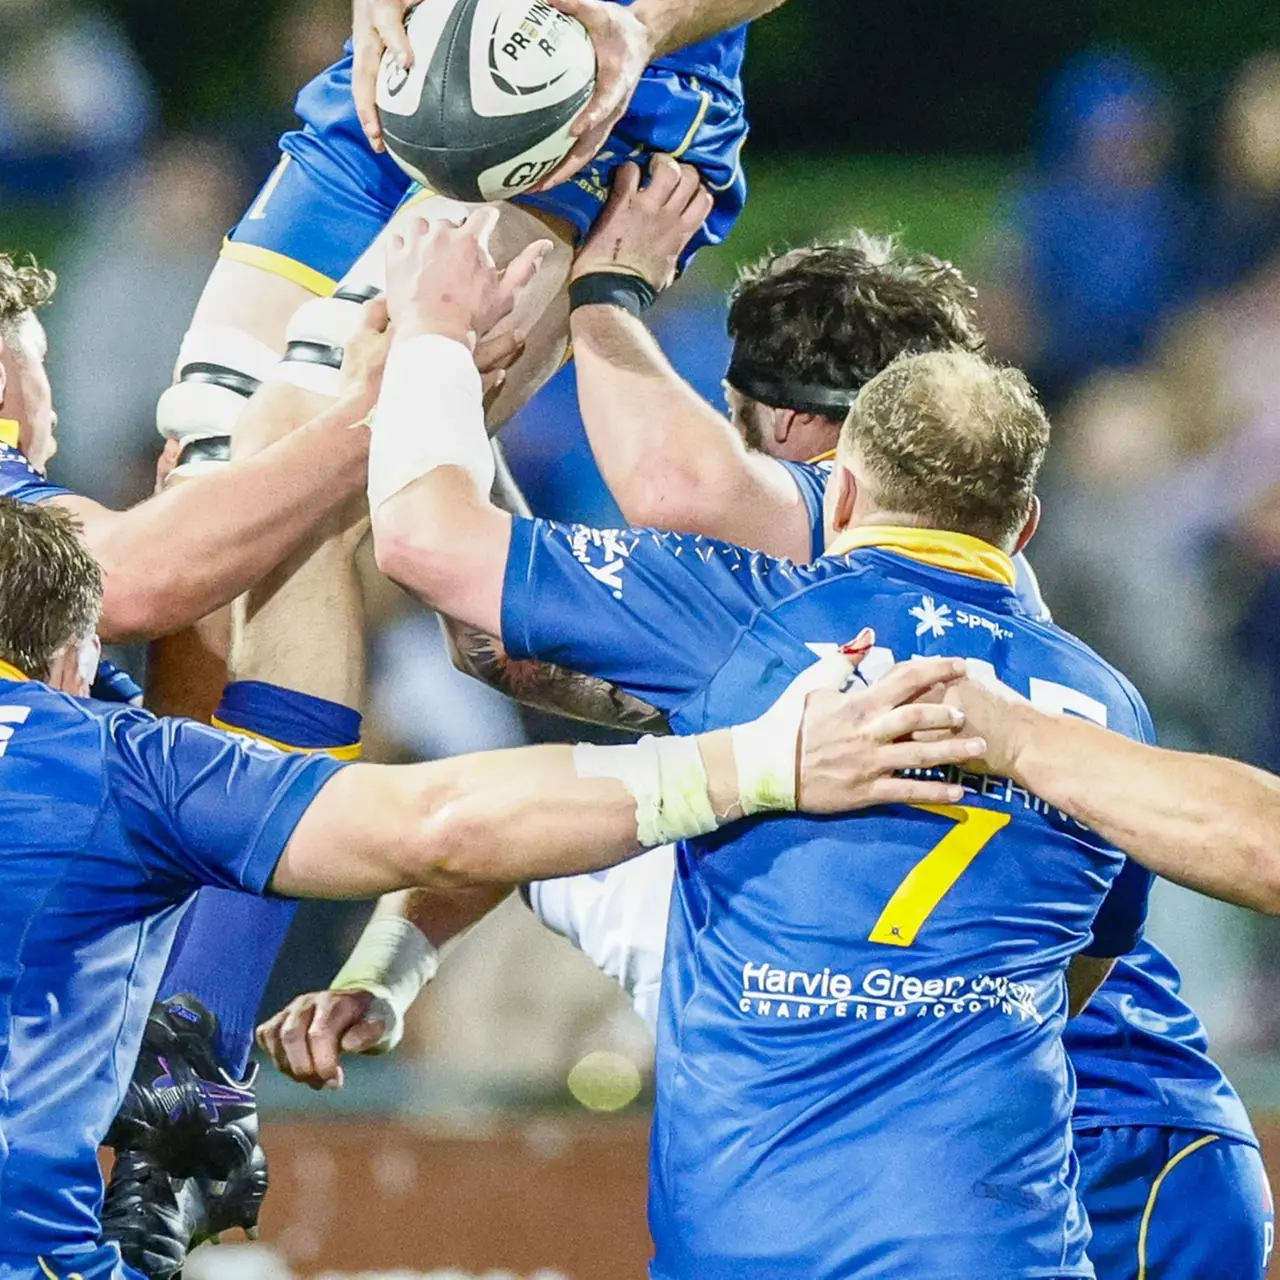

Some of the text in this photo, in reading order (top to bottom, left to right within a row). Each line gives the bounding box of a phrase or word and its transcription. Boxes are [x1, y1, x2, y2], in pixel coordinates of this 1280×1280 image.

[868, 802, 1012, 948] 7
[742, 961, 852, 998] Harvie
[862, 968, 965, 1000] Green
[739, 998, 908, 1021] CHARTERED
